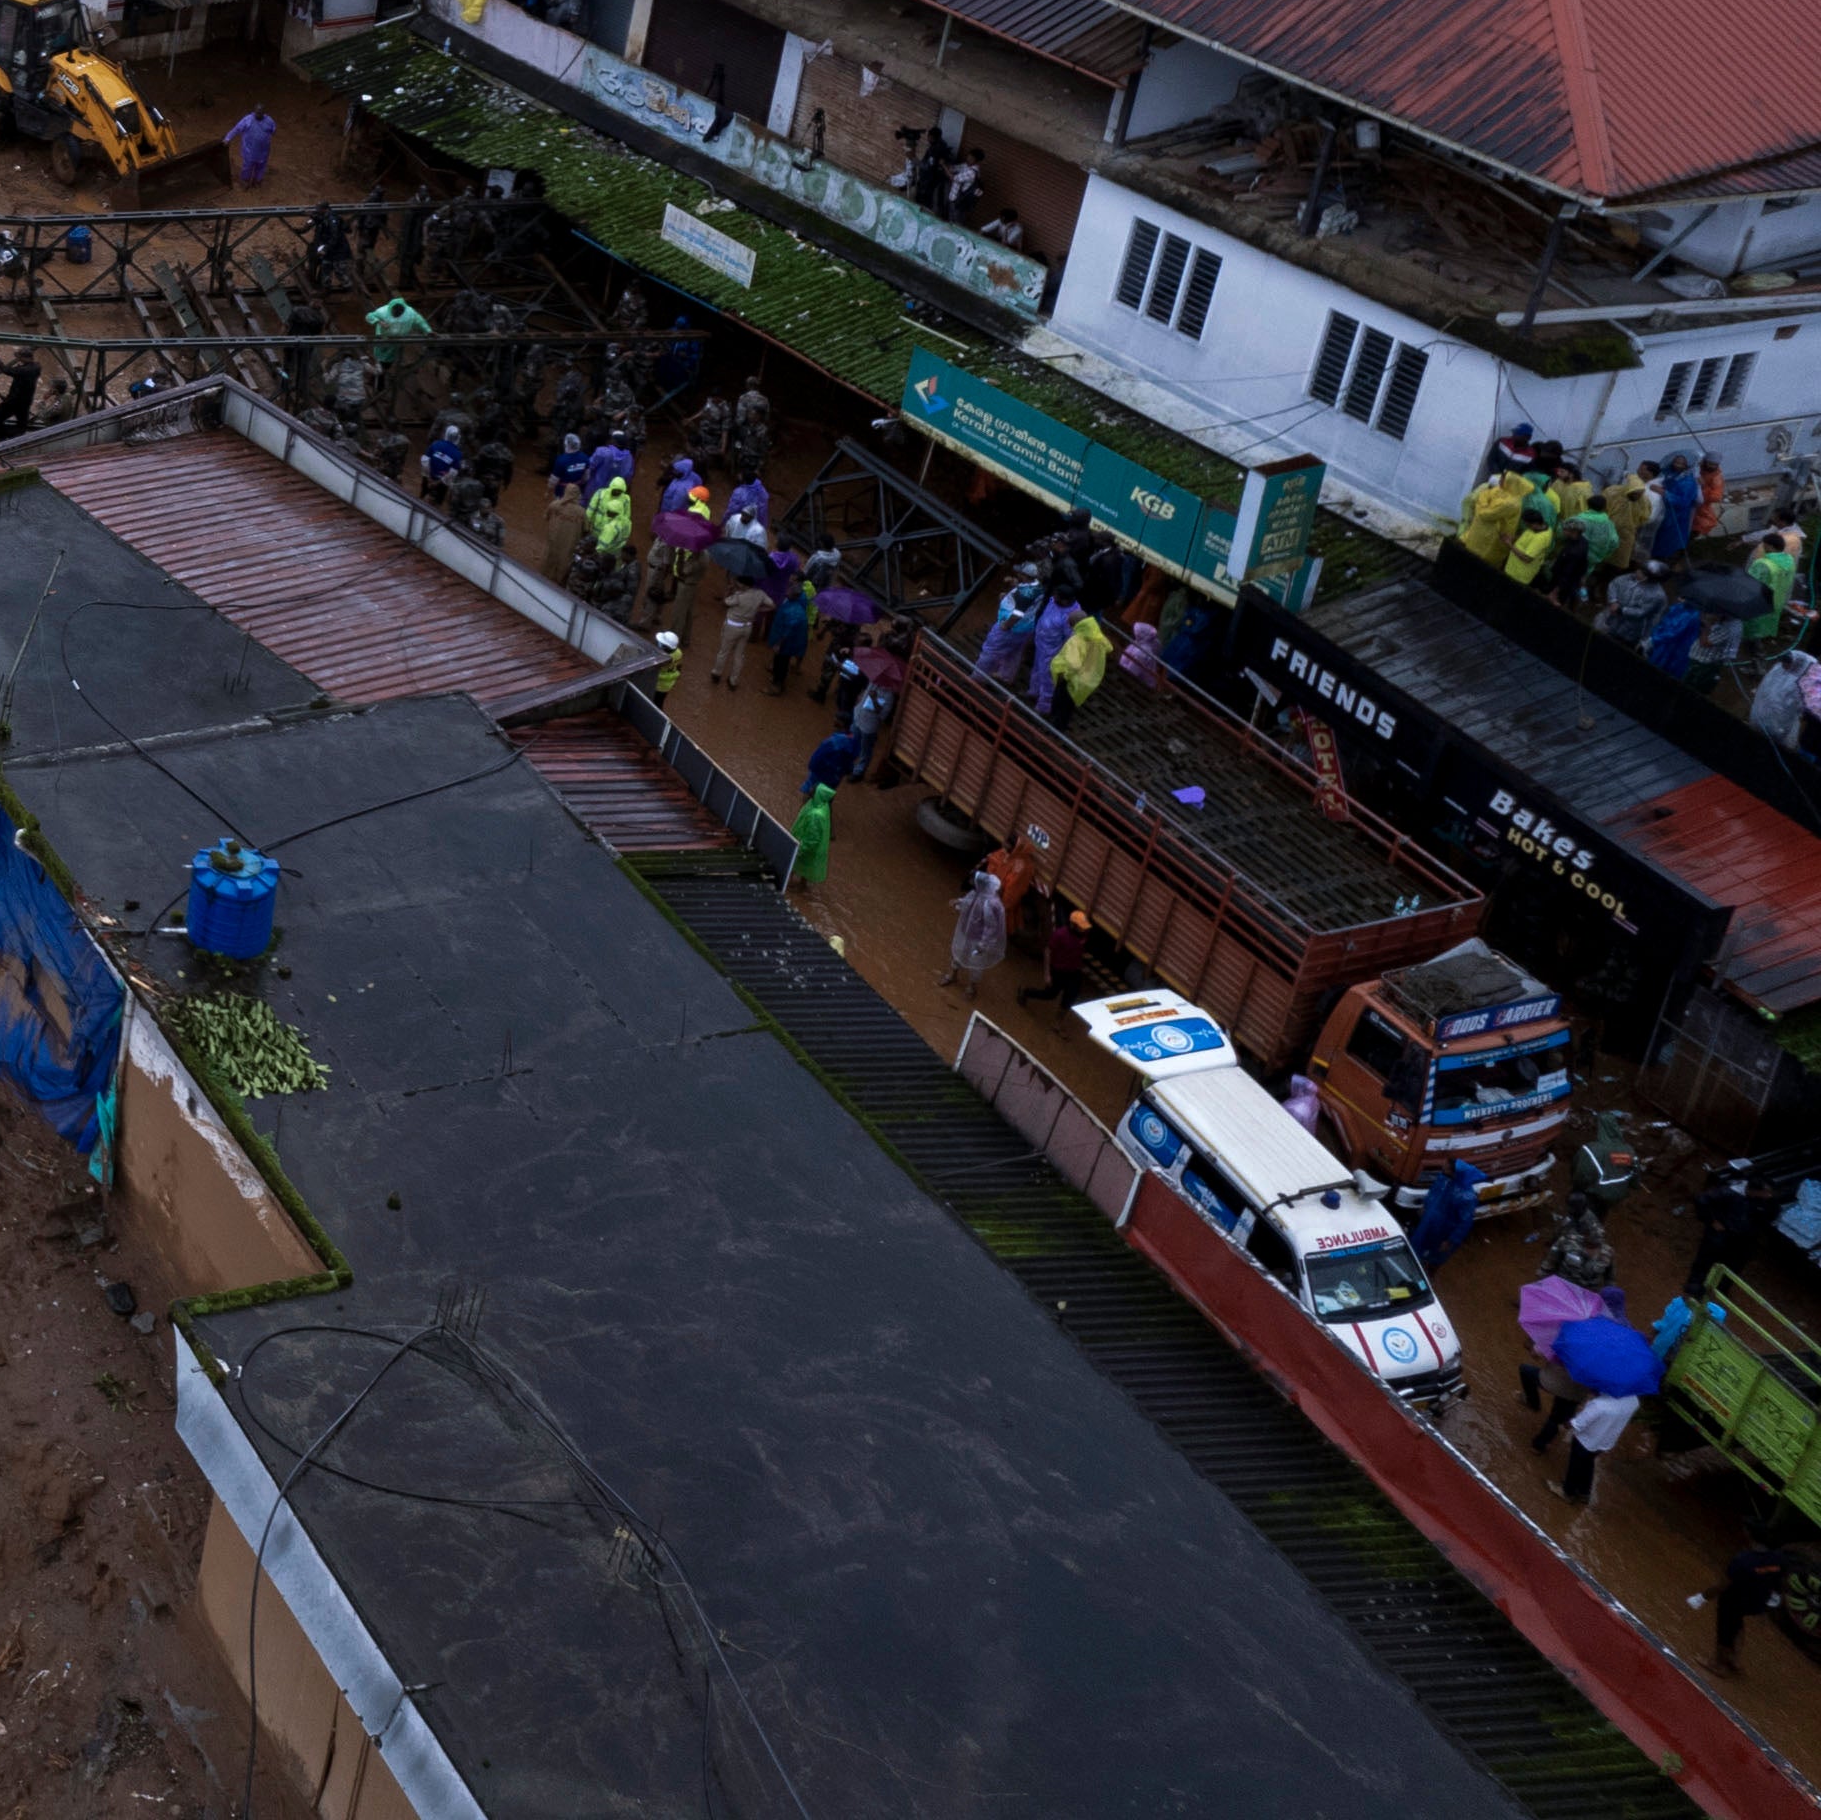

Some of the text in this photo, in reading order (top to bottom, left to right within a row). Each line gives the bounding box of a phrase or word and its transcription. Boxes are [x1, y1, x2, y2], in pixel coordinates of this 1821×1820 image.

[56, 72, 80, 96] JCB
[953, 409, 1083, 486] Kerala Gramin Bank
[1130, 485, 1176, 521] KGB
[1266, 530, 1299, 552] ATM
[1270, 636, 1397, 740] FRIENDS
[1488, 787, 1597, 870] Bakes
[1505, 826, 1628, 921] HOT & COOL
[1493, 997, 1558, 1027] CARRIER
